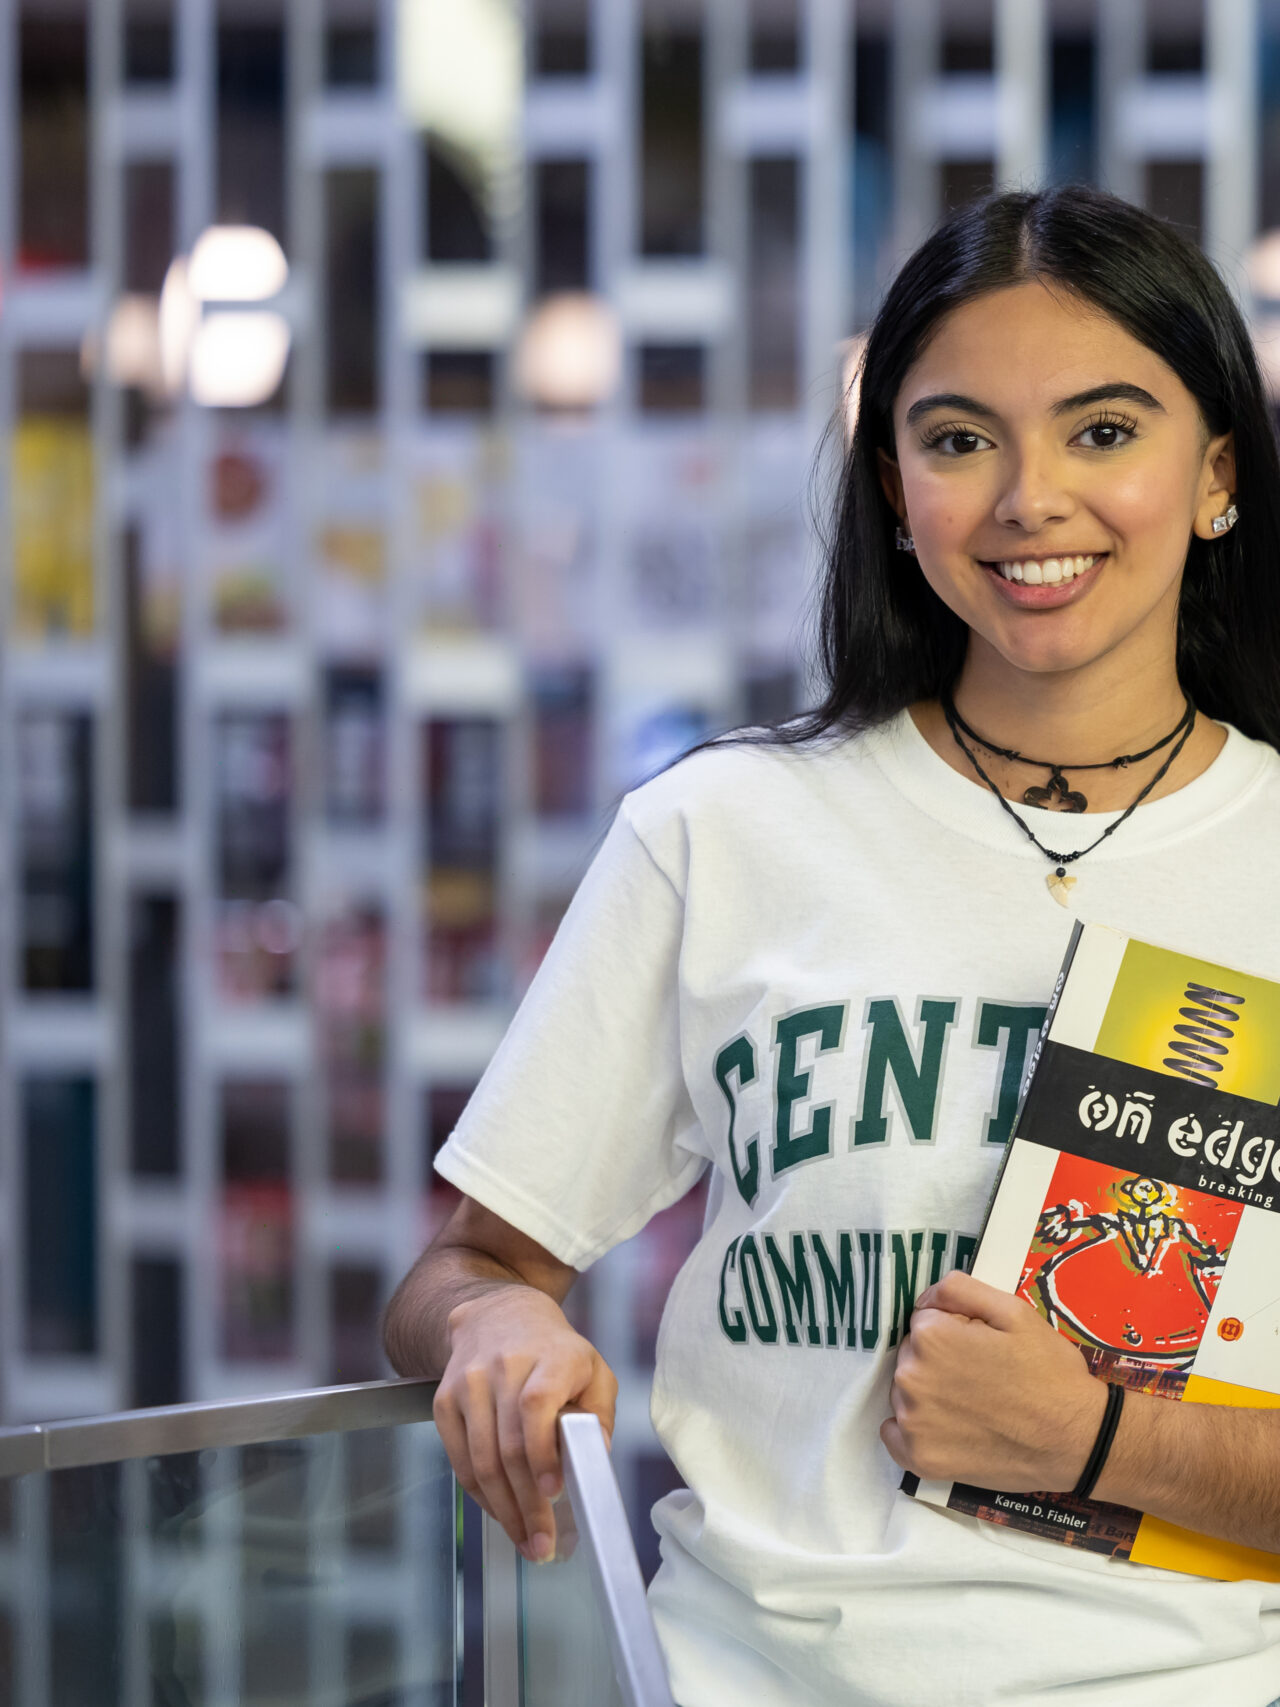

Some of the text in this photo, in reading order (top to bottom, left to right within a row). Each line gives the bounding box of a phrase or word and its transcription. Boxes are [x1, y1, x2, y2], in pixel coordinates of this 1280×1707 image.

[1078, 1085, 1155, 1144] on
[1198, 1175, 1274, 1209] breaking
[717, 1229, 979, 1351] COMMUN
[994, 1494, 1030, 1514] Karen
[1032, 1504, 1045, 1518] D.
[1046, 1509, 1087, 1529] Fishler
